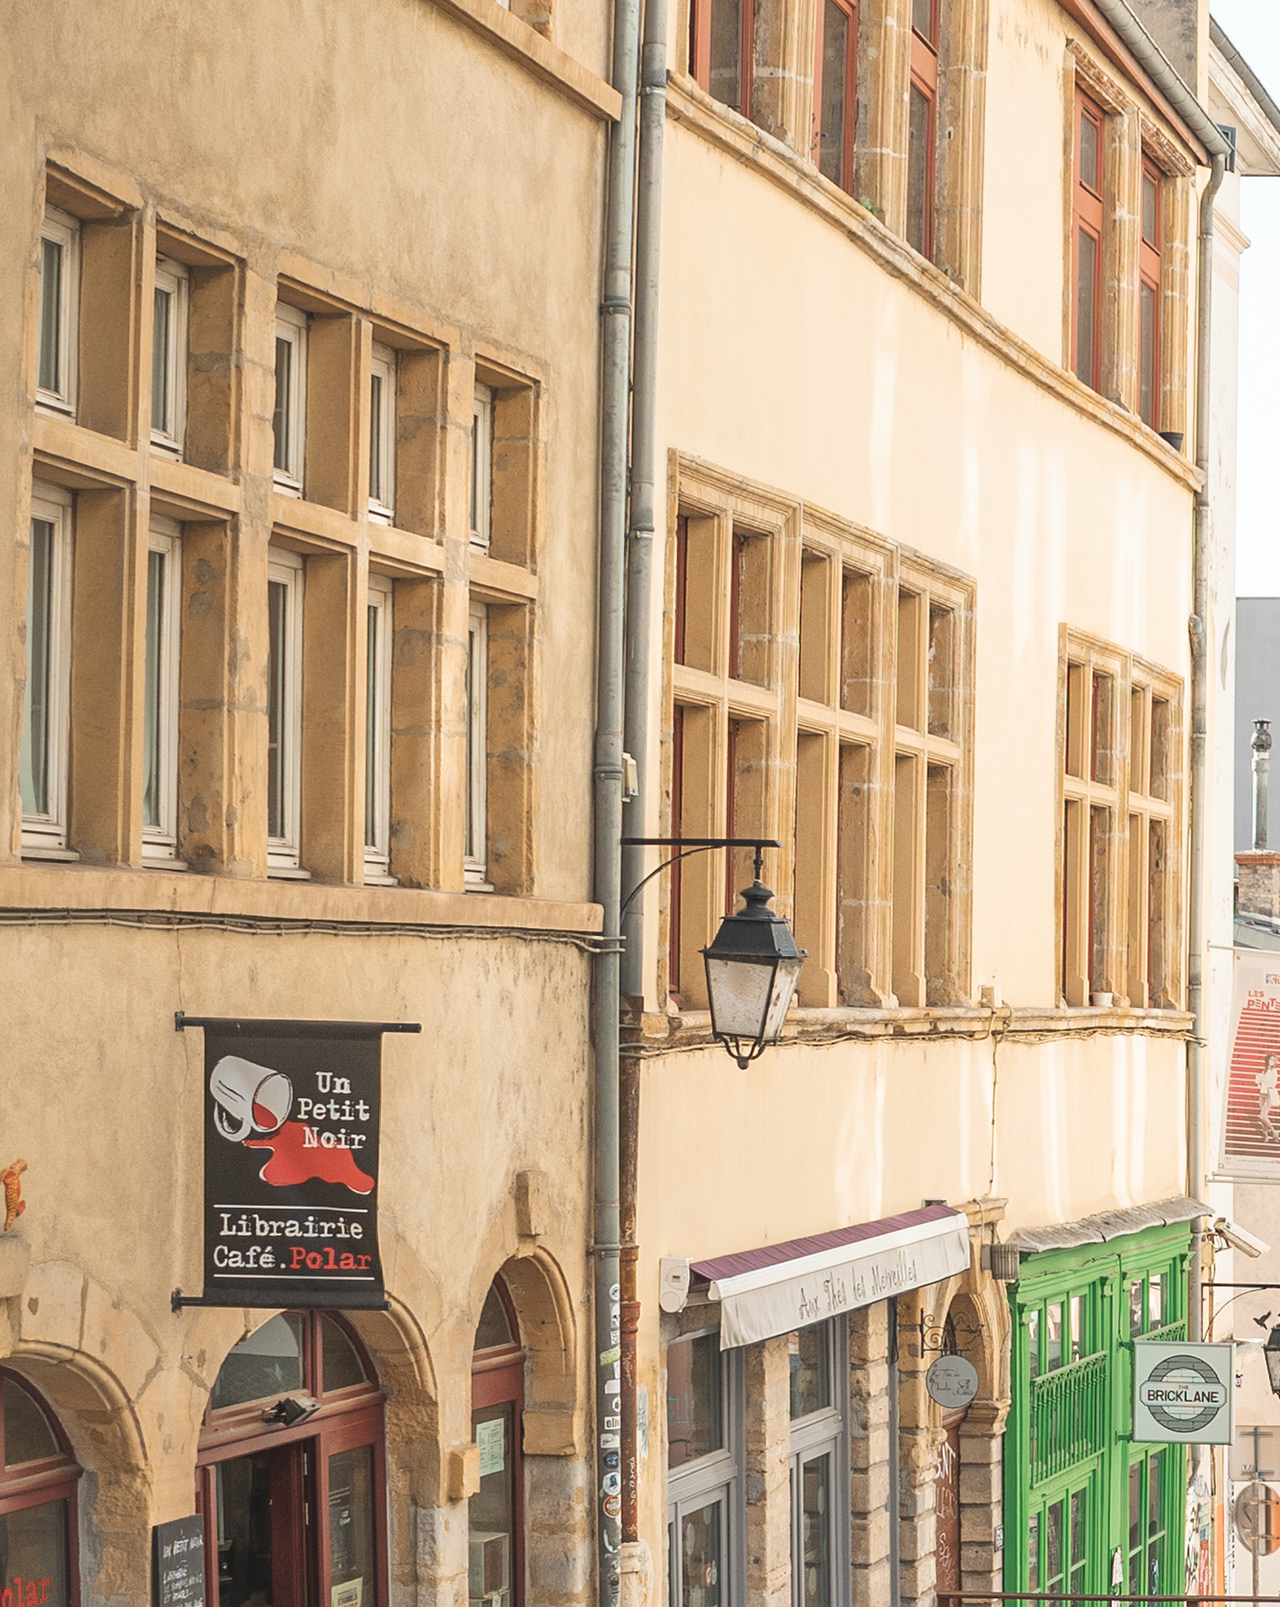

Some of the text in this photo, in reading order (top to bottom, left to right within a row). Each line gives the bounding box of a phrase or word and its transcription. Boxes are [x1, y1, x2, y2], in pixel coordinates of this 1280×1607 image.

[315, 1071, 352, 1094] Un
[297, 1098, 370, 1121] Petit
[303, 1127, 367, 1149] Noir
[219, 1213, 363, 1239] Librairie
[1147, 1389, 1220, 1403] BRICKLANE
